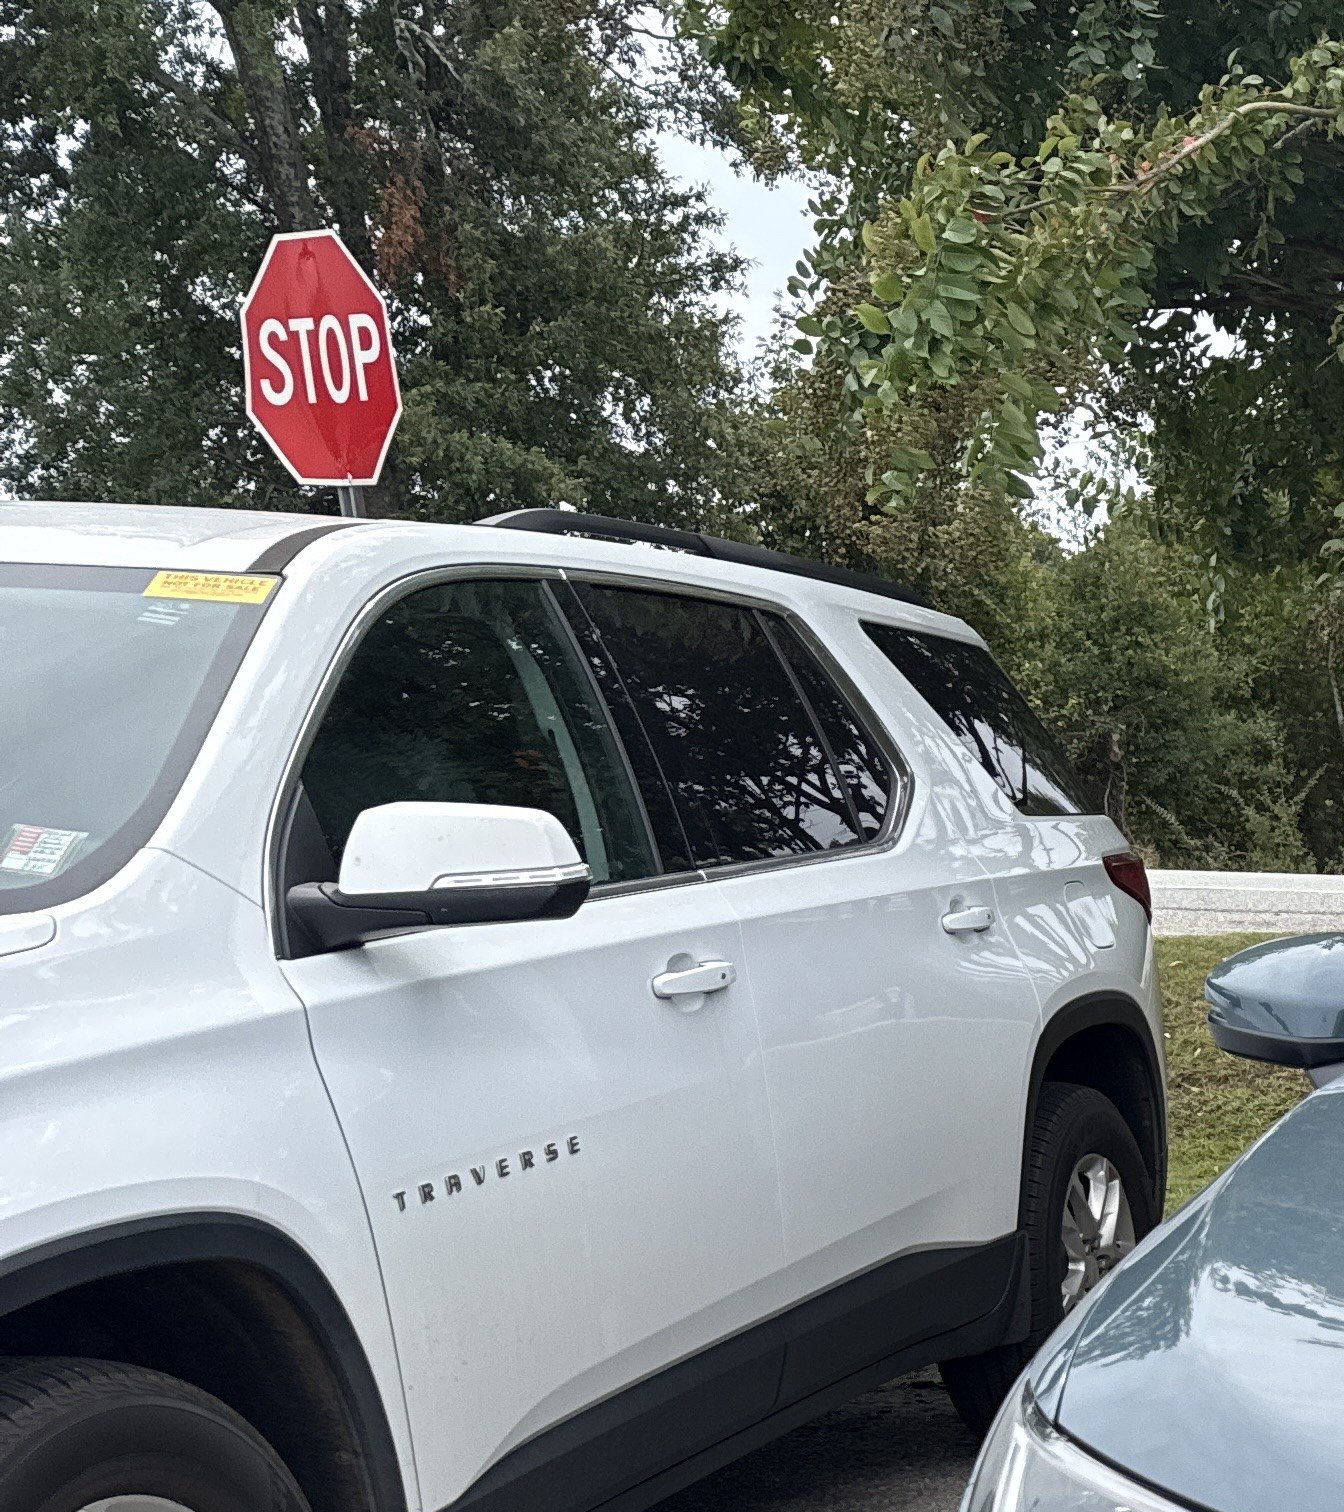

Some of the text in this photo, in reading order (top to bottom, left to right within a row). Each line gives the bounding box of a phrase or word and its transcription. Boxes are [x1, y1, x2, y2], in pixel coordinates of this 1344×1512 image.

[259, 313, 380, 406] STOP
[165, 573, 270, 587] THIS VEHICLE
[392, 1135, 581, 1212] TRAVERSE
